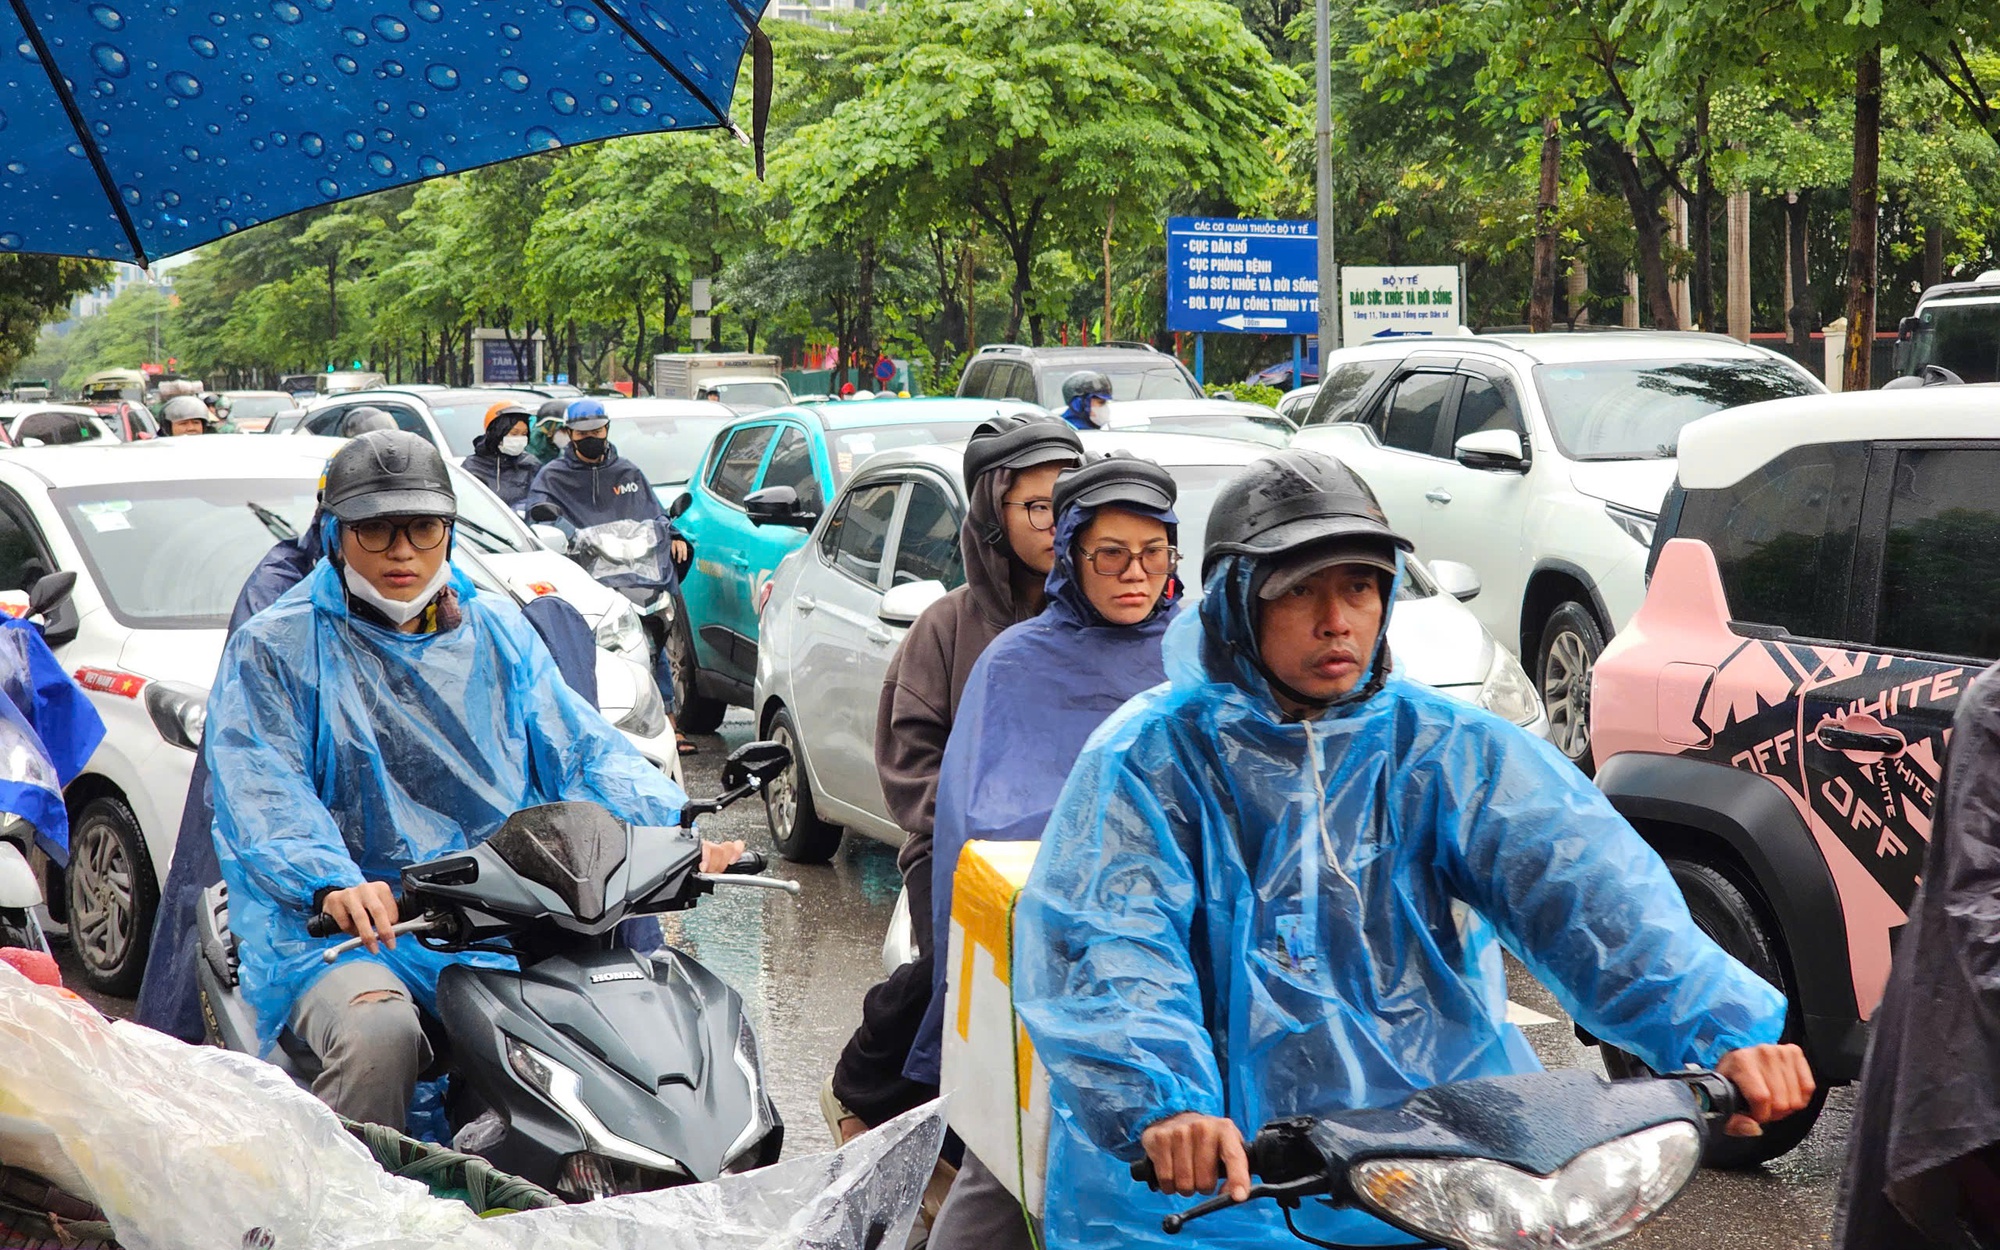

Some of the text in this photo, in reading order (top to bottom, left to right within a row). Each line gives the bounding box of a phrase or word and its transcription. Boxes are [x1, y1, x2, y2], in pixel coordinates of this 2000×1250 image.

[1194, 220, 1309, 235] CÁC CƠ QUAN THUỘC BỘ Y TẾ
[1189, 238, 1248, 255] CỤC DÂN SỐ
[1189, 255, 1272, 274] CỤC PHÒNG BỆNH
[1189, 274, 1319, 293] BÁO SỨC KHỎE VÀ ĐỜI SỐNG
[1382, 273, 1419, 287] BỘ Y TẾ
[1350, 285, 1453, 305] BÁO SỨC KHỎE VÀ ĐỜI SỐNG
[1189, 296, 1208, 310] BQL
[1210, 295, 1225, 312] DỰ
[1225, 295, 1241, 310] ÁN
[1243, 295, 1270, 311] CÔNG
[1271, 296, 1300, 312] TRÌNH
[1301, 299, 1308, 313] Y
[1244, 318, 1260, 326] 100m
[613, 482, 638, 495] VMO
[1821, 775, 1909, 859] OFF
[591, 970, 645, 984] HONDA
